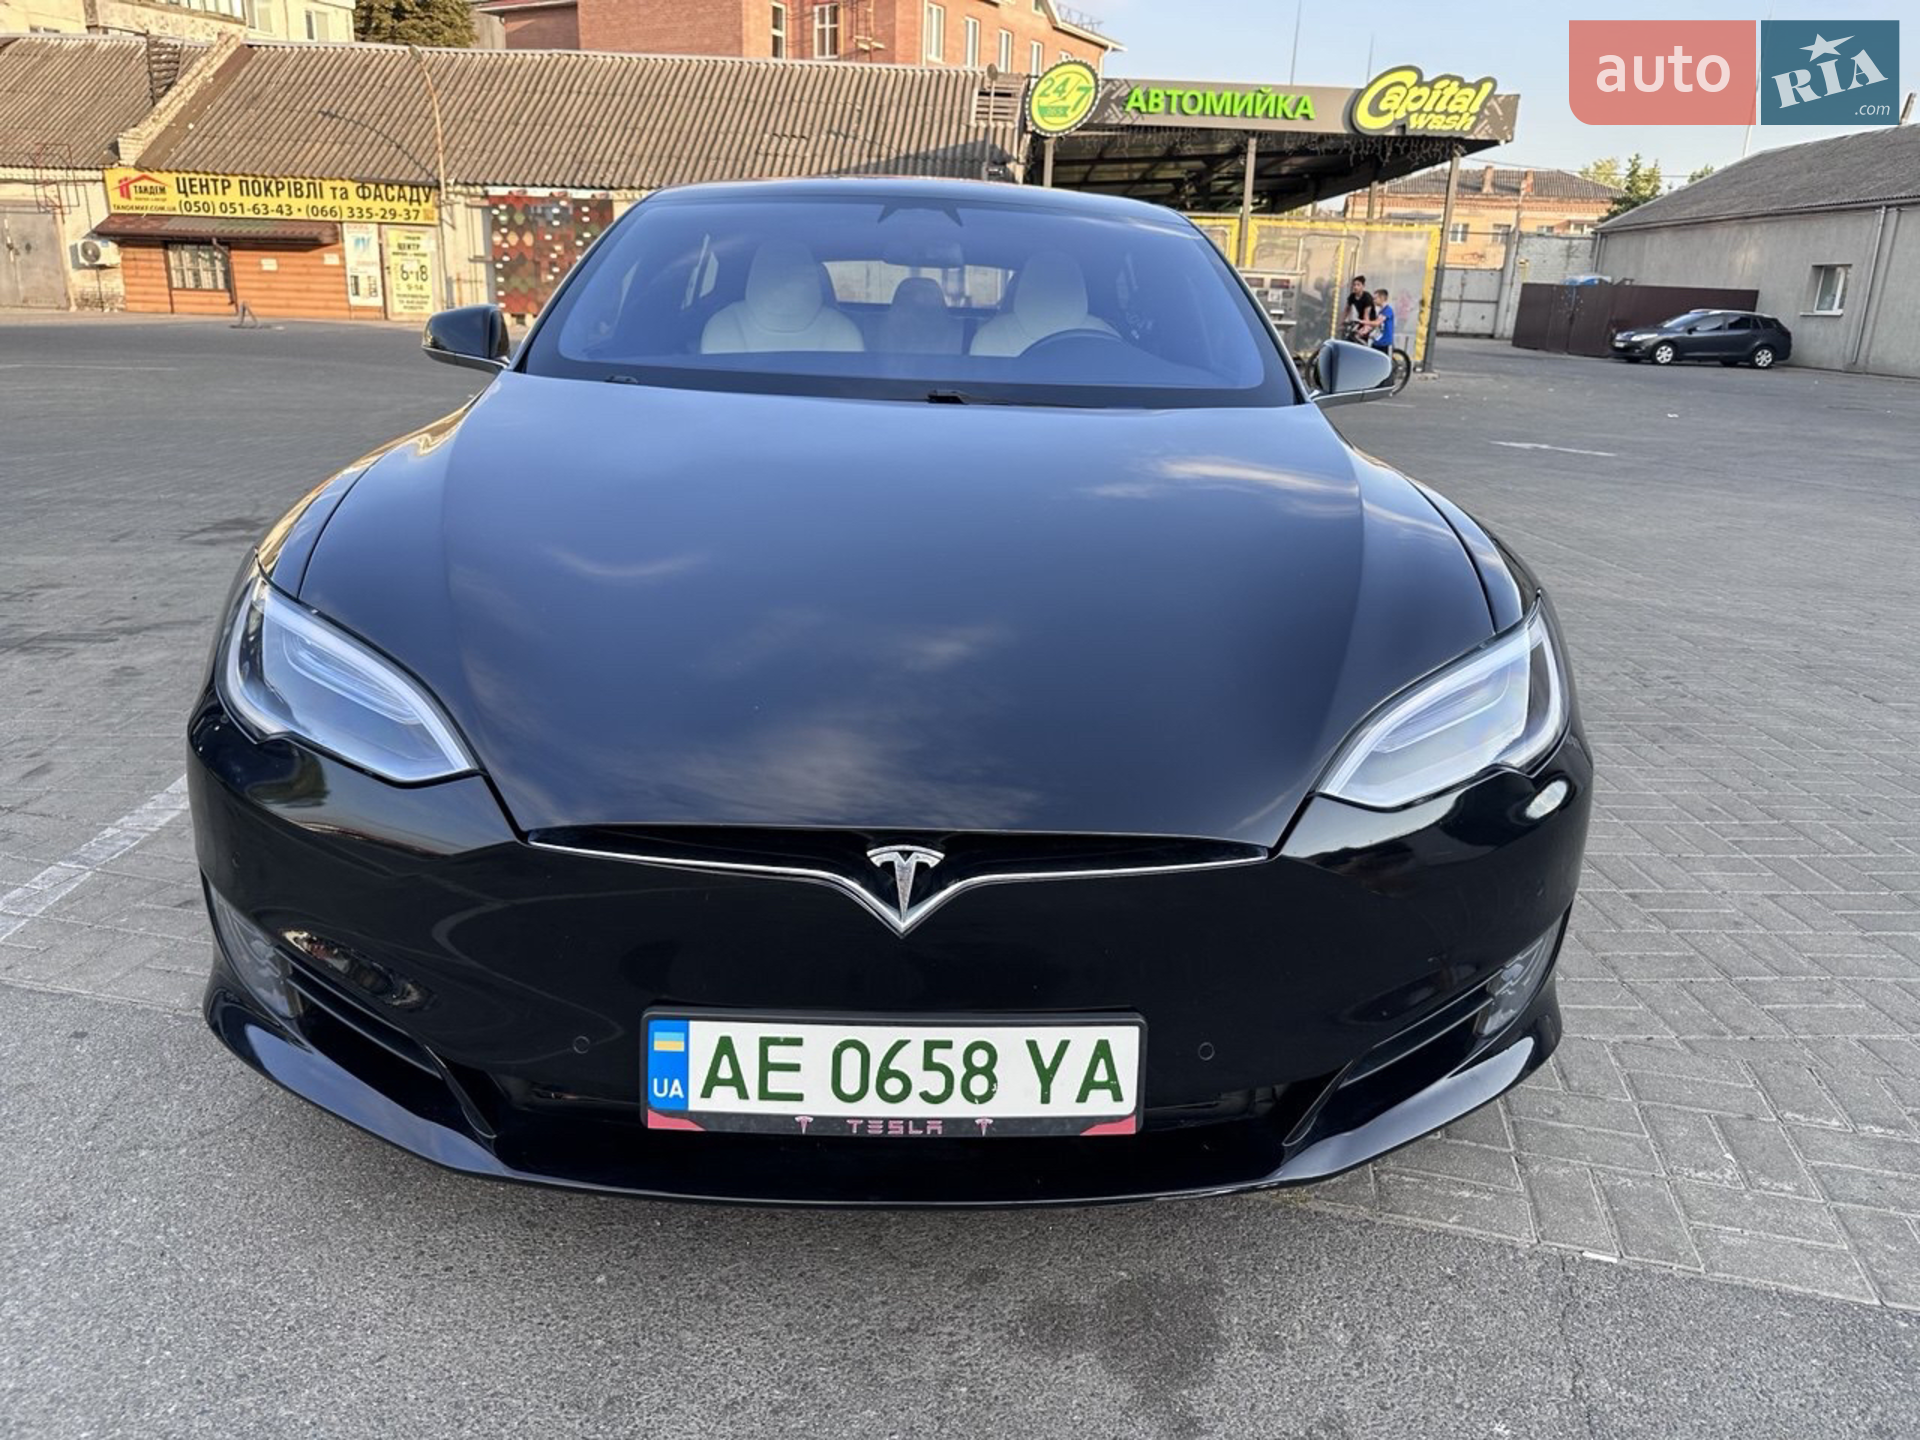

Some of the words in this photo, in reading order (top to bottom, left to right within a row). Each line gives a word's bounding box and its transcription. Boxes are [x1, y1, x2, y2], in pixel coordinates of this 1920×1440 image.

[1124, 85, 1316, 120] АВТОМИЙКА
[1356, 70, 1494, 130] Capital
[1409, 111, 1477, 131] wash
[133, 185, 167, 195] ТАНДЕМ
[175, 176, 231, 198] ЦЕНТР
[239, 178, 324, 200] ПОКРІВЛІ
[329, 186, 349, 200] та
[355, 182, 433, 206] ФАСАДУ
[178, 200, 216, 215] (050)
[219, 202, 293, 216] 051-63-43
[305, 204, 343, 219] (066)
[347, 206, 420, 221] 335-29-37
[700, 1035, 804, 1101] AE
[831, 1039, 998, 1104] 0658
[1025, 1038, 1124, 1104] YA
[653, 1078, 684, 1098] UA
[846, 1118, 943, 1135] TESLA
